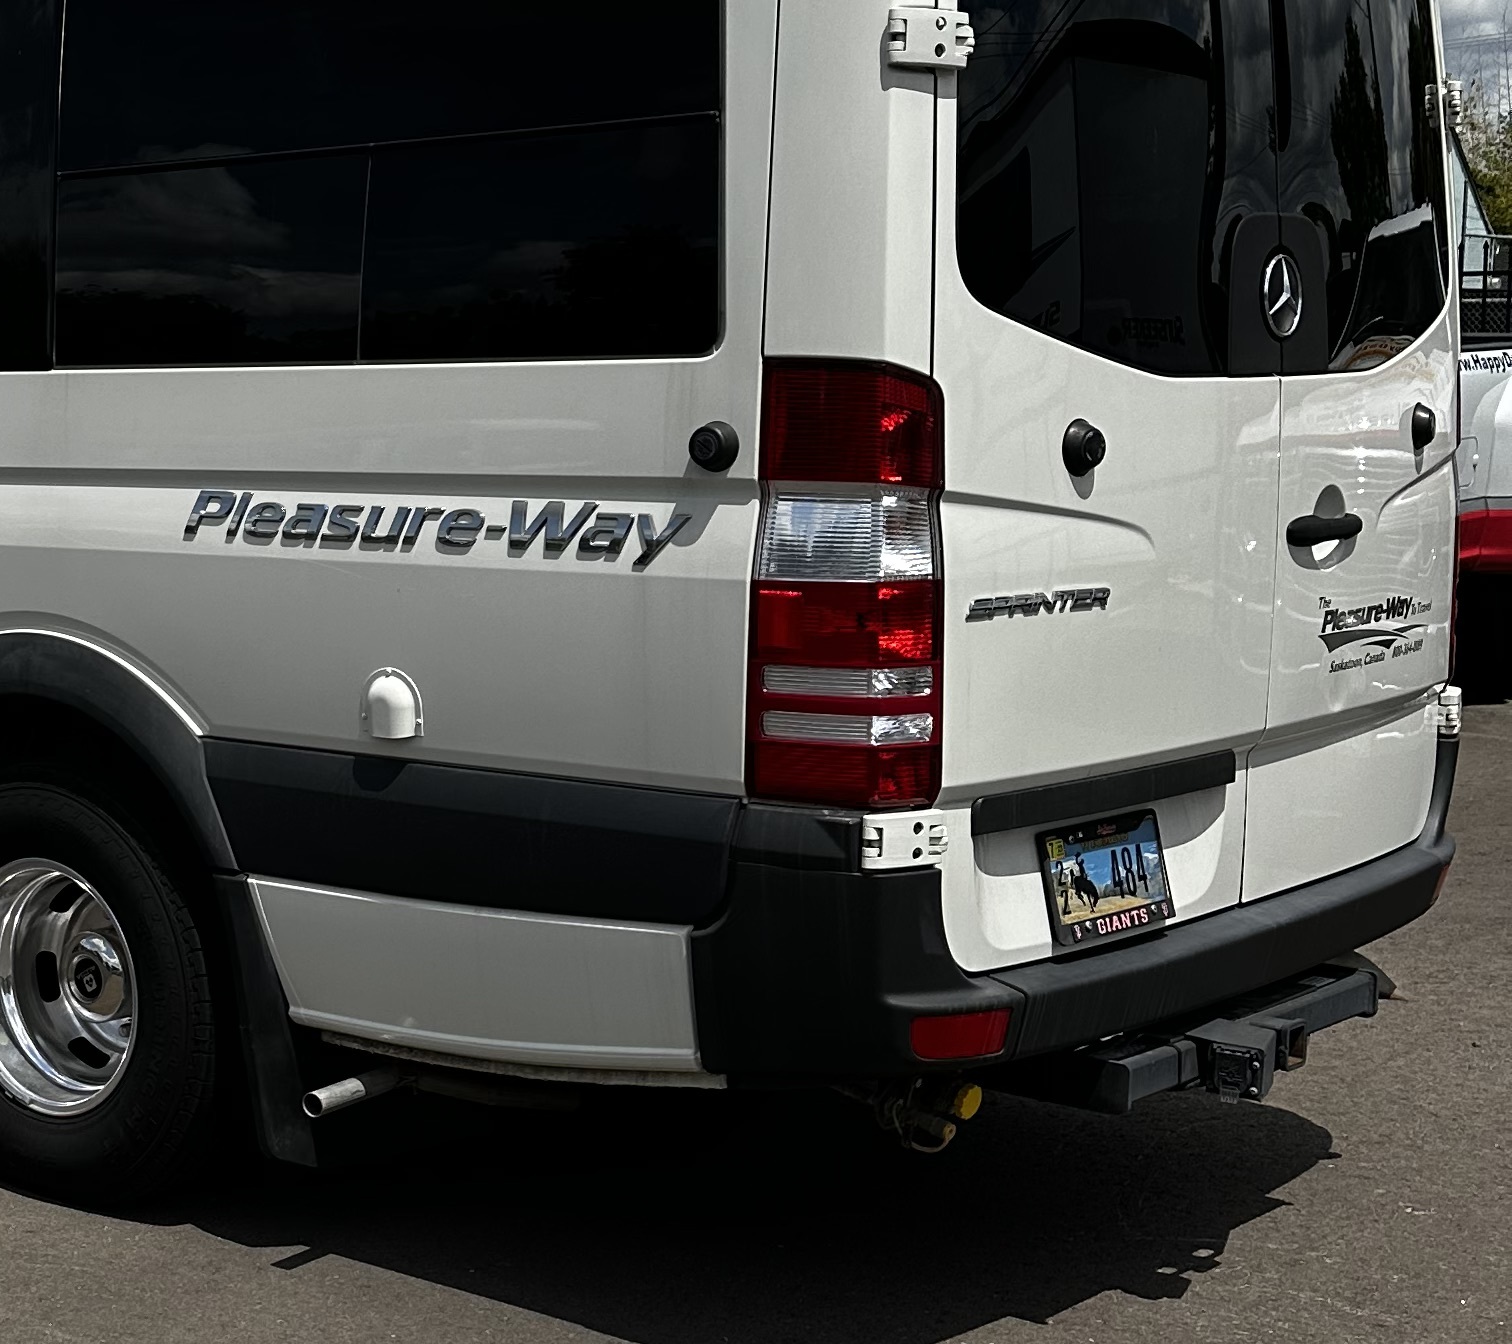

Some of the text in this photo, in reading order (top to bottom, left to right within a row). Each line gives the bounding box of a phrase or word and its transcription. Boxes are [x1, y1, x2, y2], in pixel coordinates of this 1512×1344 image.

[184, 489, 693, 572] Pleasure-Way
[965, 587, 1111, 623] SPRINTER
[1320, 596, 1414, 633] Pleasure-Way
[1110, 843, 1150, 899] 484
[1096, 907, 1150, 935] GIANTS
